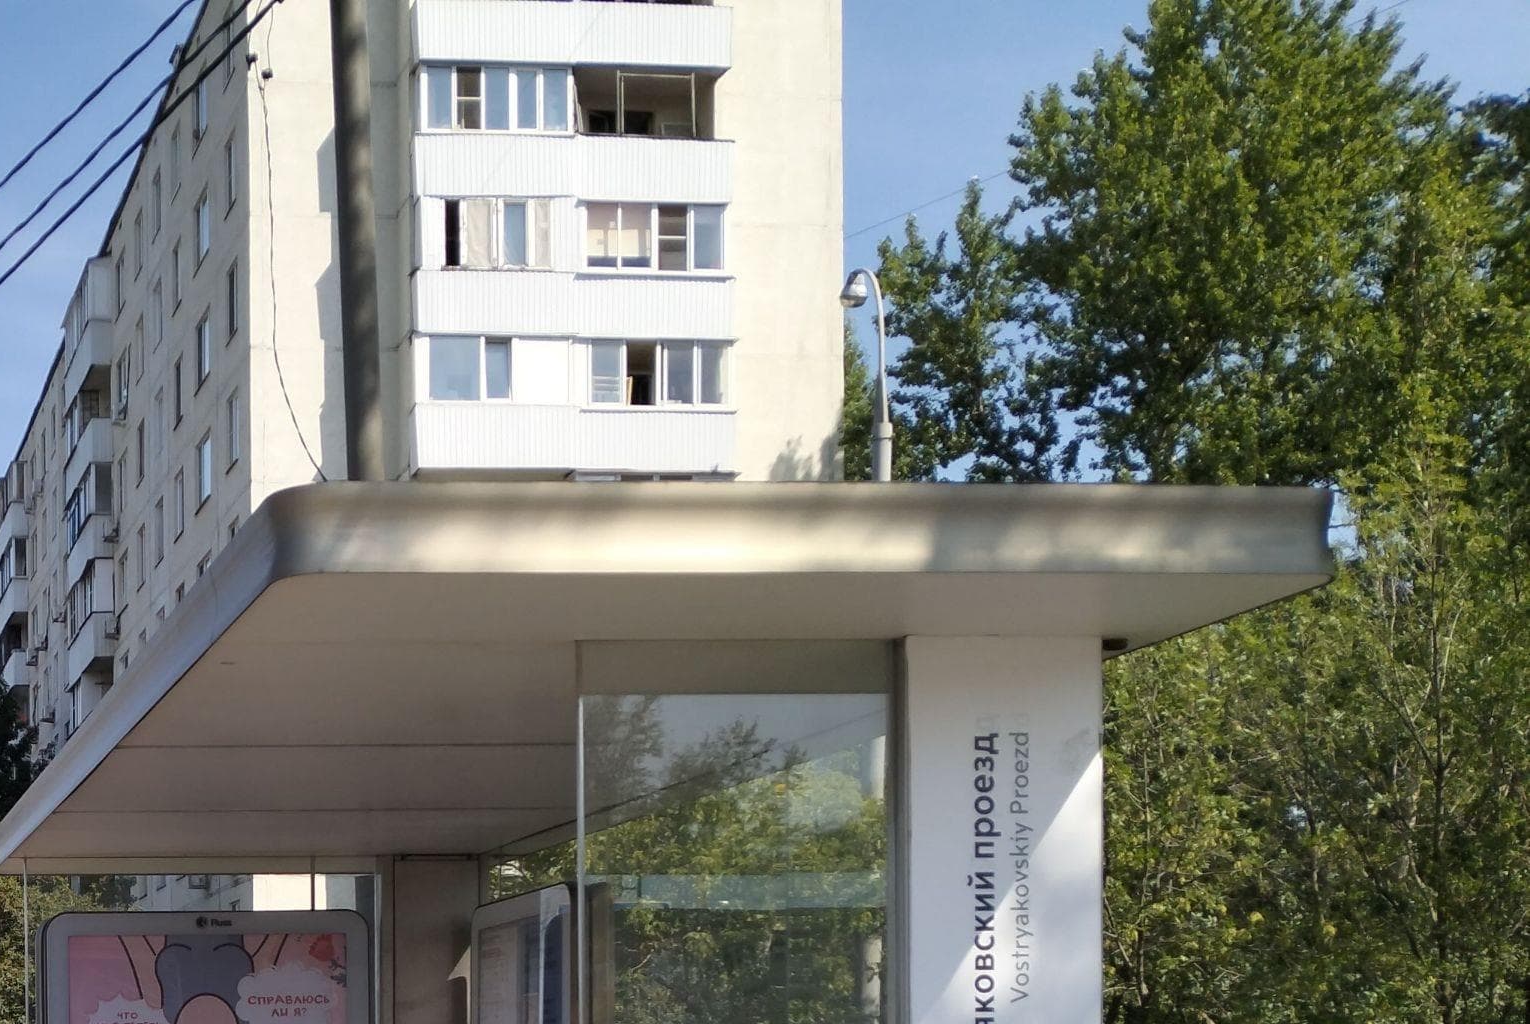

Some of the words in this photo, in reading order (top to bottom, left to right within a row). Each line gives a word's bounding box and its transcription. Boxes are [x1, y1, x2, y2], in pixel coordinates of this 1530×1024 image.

[1010, 731, 1030, 813] Proezd
[974, 733, 1001, 859] проезд
[1010, 823, 1034, 1003] Vostryakovskiy
[117, 1011, 139, 1019] ЧТО
[247, 994, 330, 1005] СПРАВЛЮСЬ
[271, 1008, 288, 1017] ЛИ
